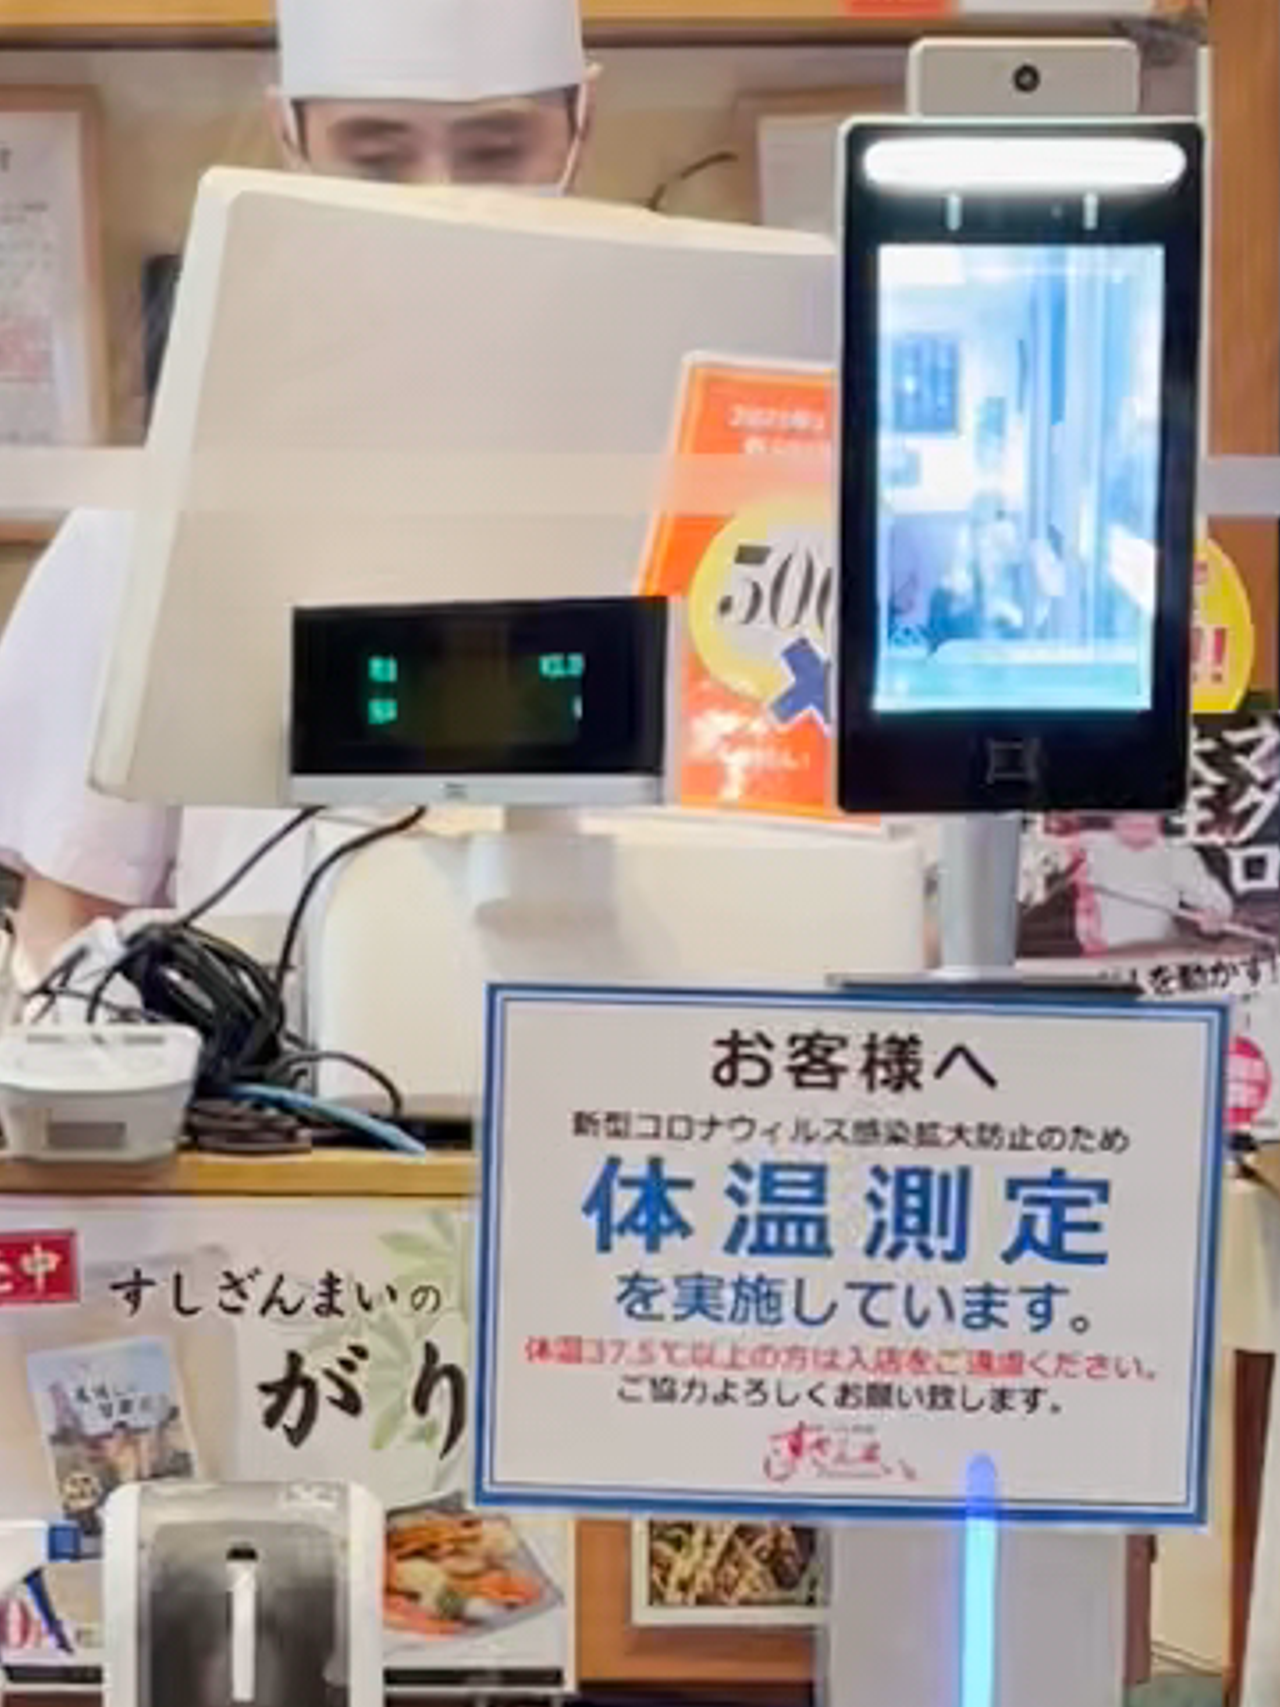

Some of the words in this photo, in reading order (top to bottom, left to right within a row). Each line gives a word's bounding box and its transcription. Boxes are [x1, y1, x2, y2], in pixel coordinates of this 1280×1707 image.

[710, 1029, 999, 1092] お客様へ
[581, 1155, 1112, 1266] 体温測定
[109, 1266, 443, 1318] すしざんまいの
[615, 1272, 1092, 1336] を実施しています。
[257, 1338, 469, 1461] がり
[617, 1373, 1063, 1415] ご協力よろしくお願い致します。
